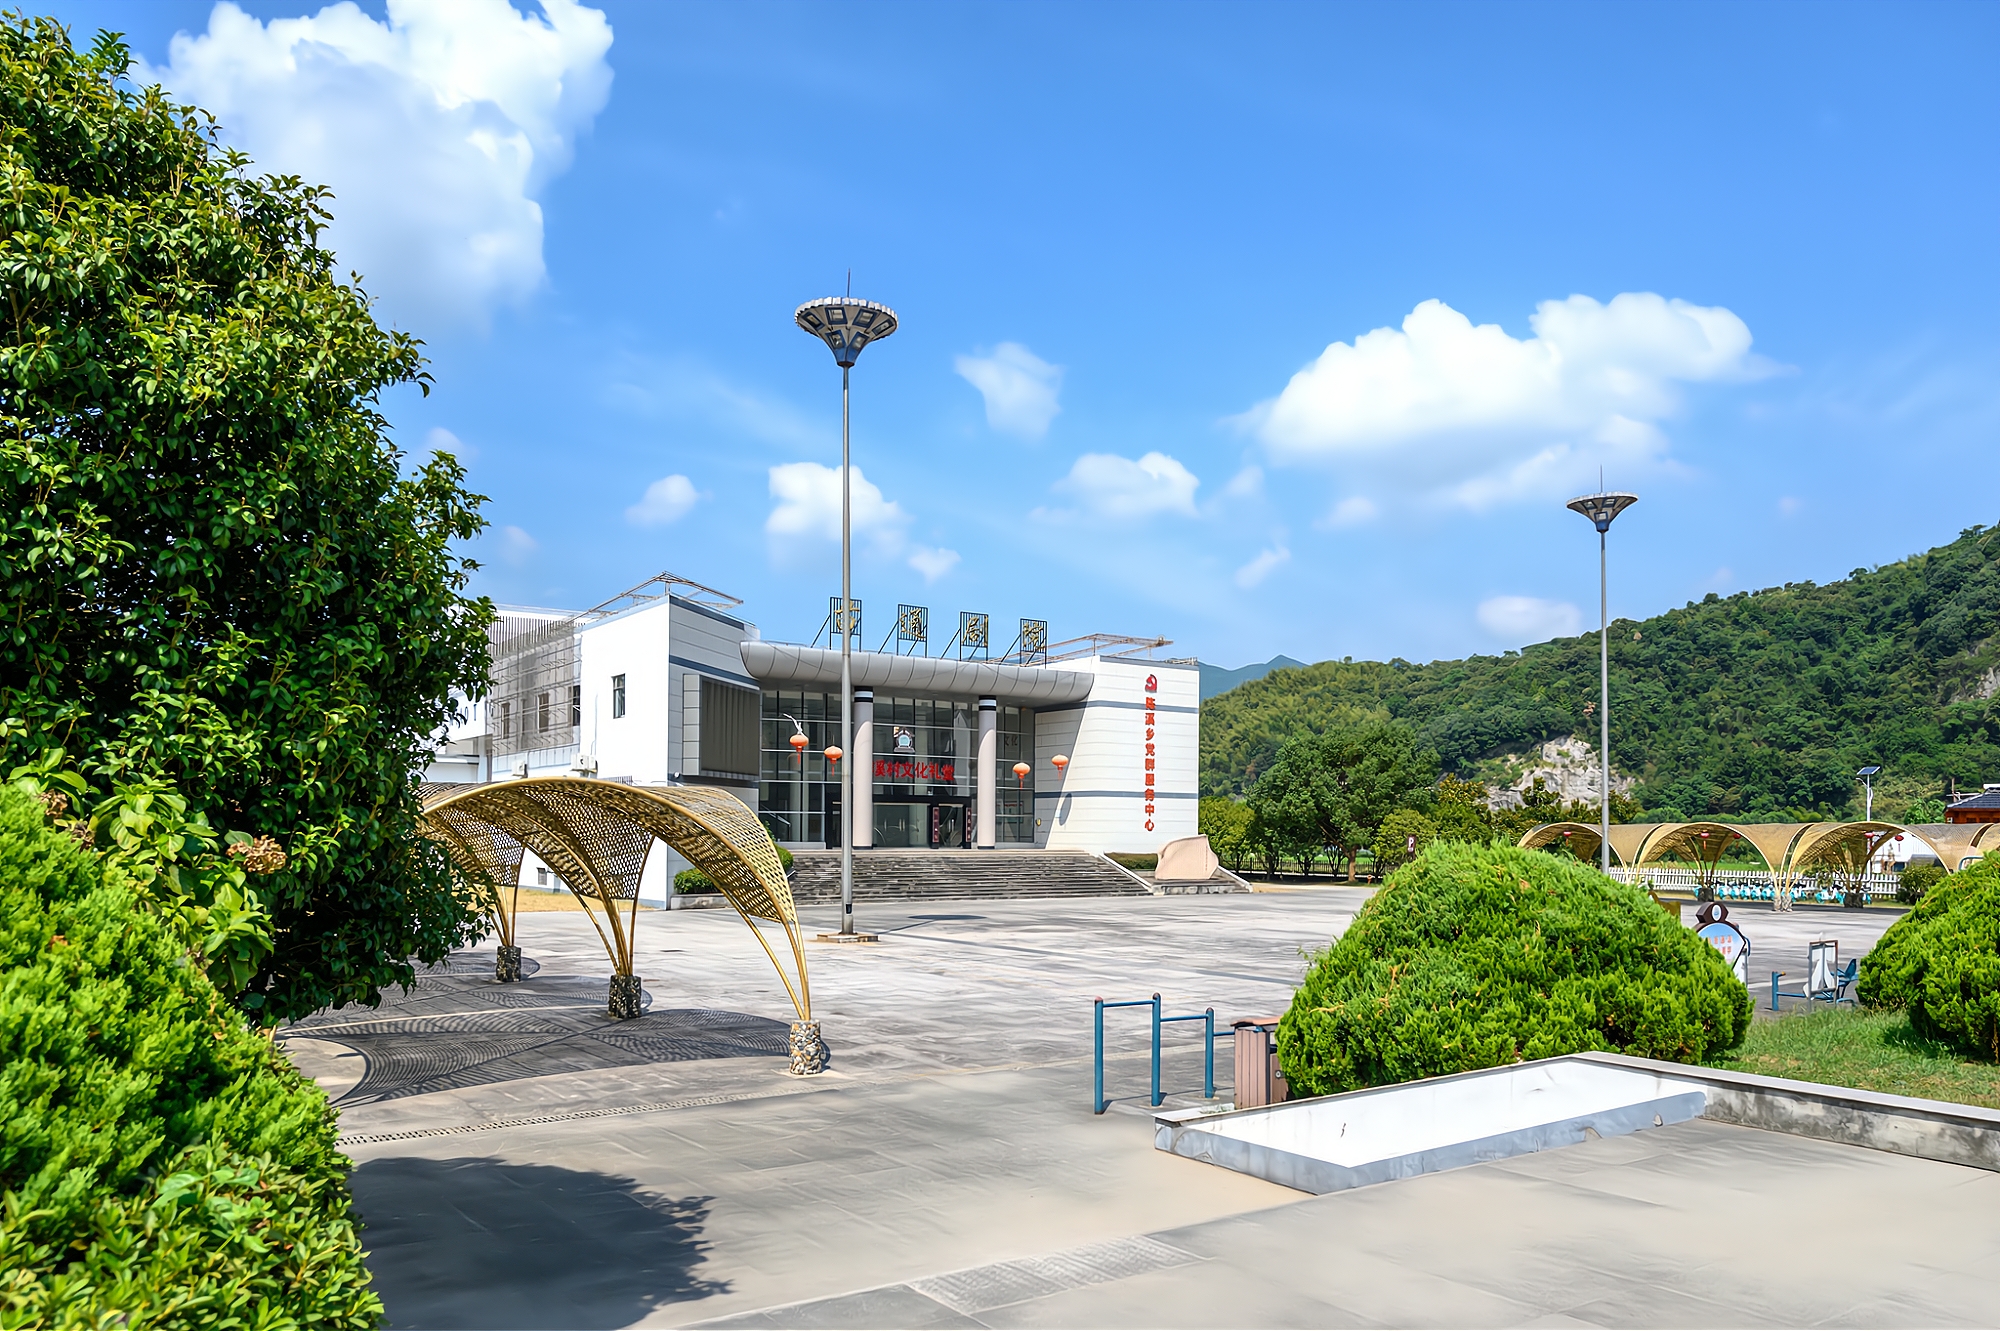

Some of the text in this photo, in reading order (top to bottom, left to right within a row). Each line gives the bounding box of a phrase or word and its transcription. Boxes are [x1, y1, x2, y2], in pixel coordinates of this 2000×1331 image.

[1144, 696, 1156, 832] 陈溪乡党群服务中心
